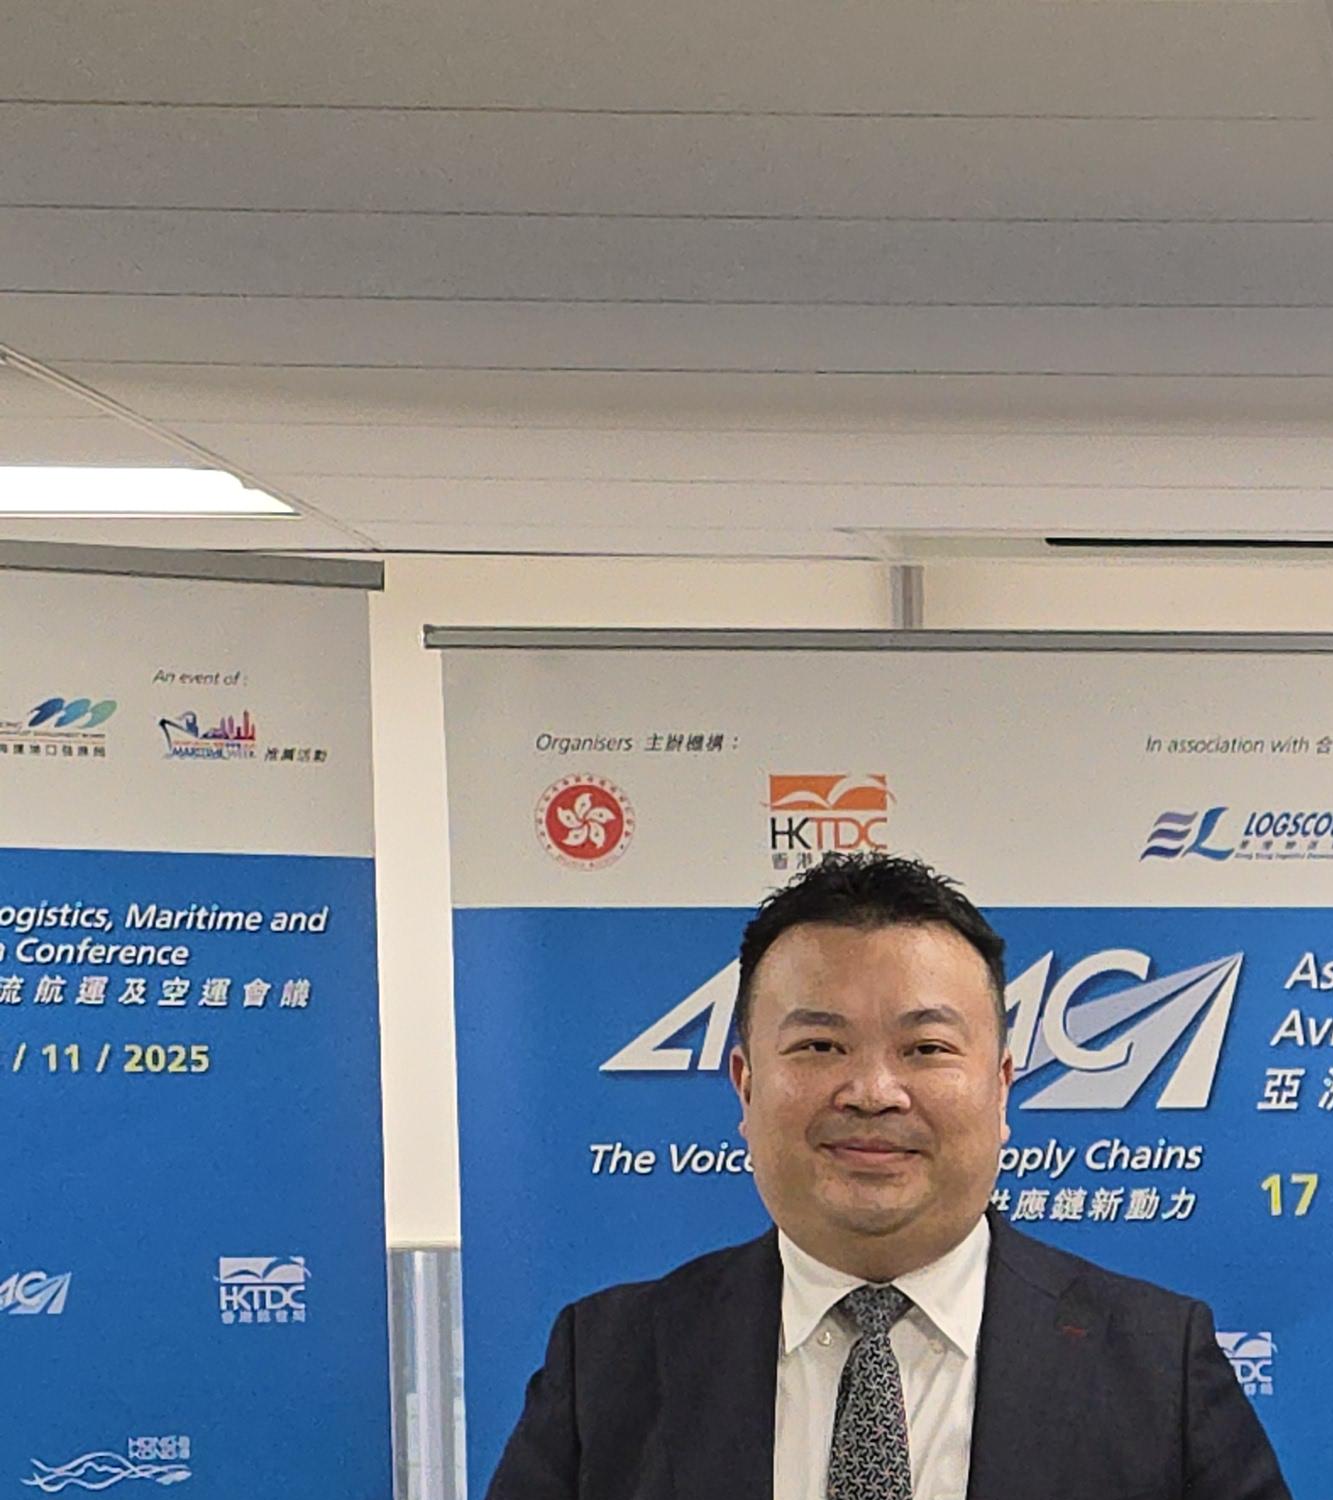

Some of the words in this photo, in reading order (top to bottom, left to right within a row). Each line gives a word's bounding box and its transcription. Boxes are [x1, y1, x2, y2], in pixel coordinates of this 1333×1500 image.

[153, 669, 175, 684] An
[179, 670, 220, 685] event
[223, 670, 241, 686] of
[536, 733, 633, 755] Organisers
[1145, 735, 1161, 753] In
[1167, 735, 1264, 754] association
[1271, 735, 1310, 754] with
[769, 816, 888, 850] HKTDC
[0, 901, 113, 934] ogistics,
[125, 904, 262, 932] Maritime
[270, 906, 328, 933] and
[15, 937, 189, 966] Conference
[41, 1044, 80, 1072] 11
[123, 1044, 210, 1073] 2025
[590, 1143, 655, 1174] The
[999, 1141, 1076, 1179] pply
[1085, 1138, 1203, 1171] Chains
[990, 1186, 1197, 1222] 應鏈新動力
[1260, 1172, 1320, 1217] 17
[219, 1285, 306, 1310] HKTDC
